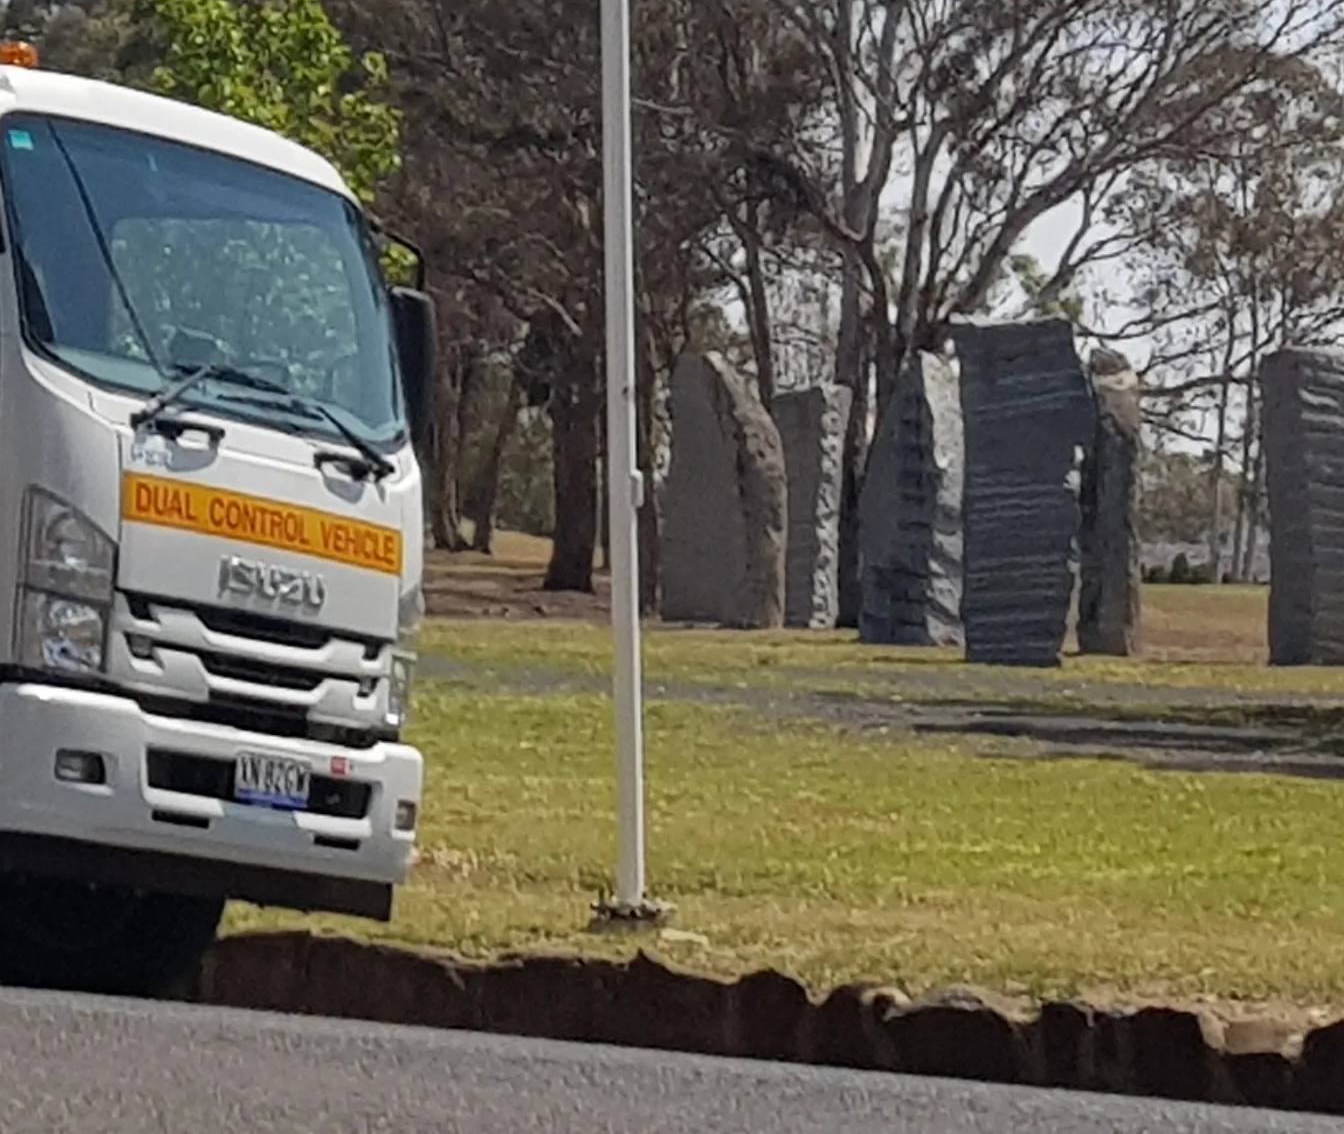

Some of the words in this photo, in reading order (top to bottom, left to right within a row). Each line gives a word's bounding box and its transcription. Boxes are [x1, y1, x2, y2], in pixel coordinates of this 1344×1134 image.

[135, 482, 197, 521] DUAL
[209, 497, 310, 545] CONTROL
[320, 521, 395, 565] VEHICLE
[218, 555, 325, 606] ISUZU
